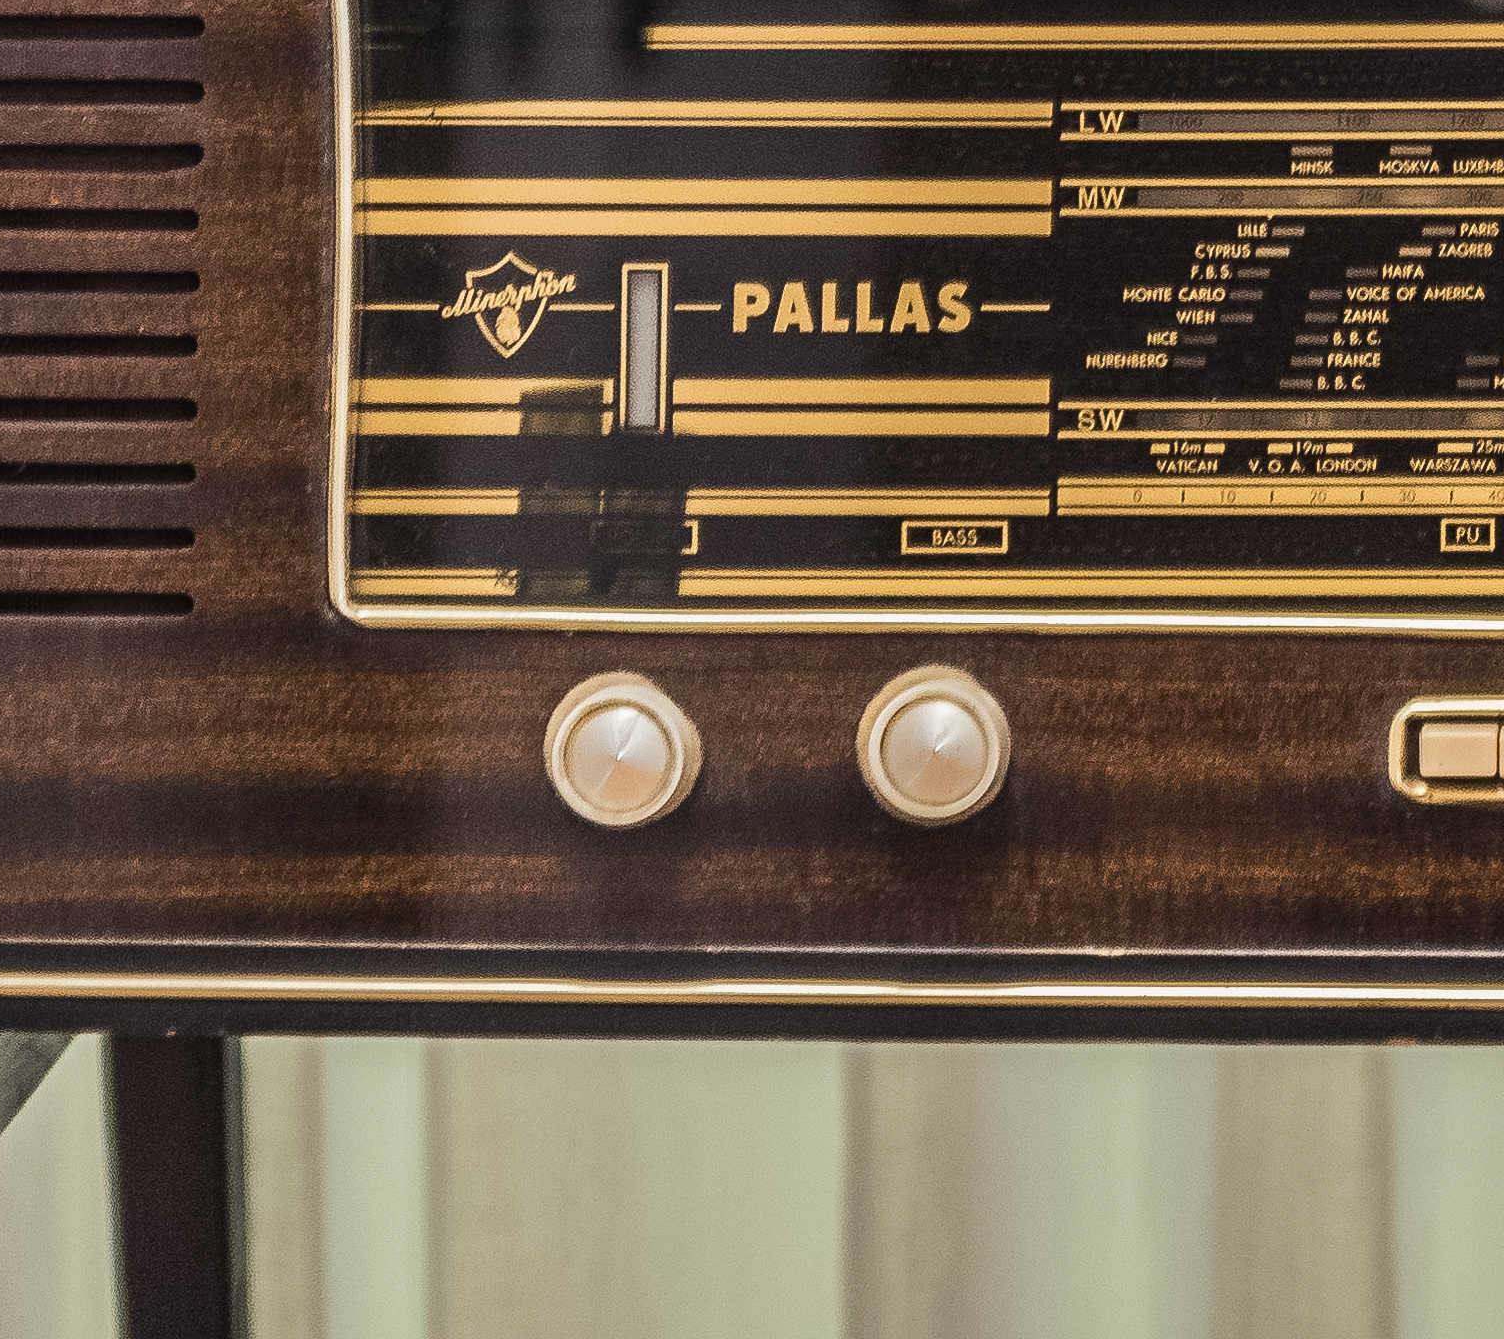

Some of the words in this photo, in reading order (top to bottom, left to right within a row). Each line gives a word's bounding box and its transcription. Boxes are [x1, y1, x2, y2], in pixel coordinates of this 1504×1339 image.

[1078, 111, 1125, 133] LW
[1378, 159, 1440, 174] MOSKVA
[1078, 186, 1125, 209] MW
[1460, 221, 1500, 237] PARIS
[1194, 243, 1252, 260] CYPRUS
[1438, 242, 1493, 258] ZAGREB
[1122, 286, 1173, 303] MONTE
[1177, 286, 1226, 303] CARLO
[1346, 286, 1390, 302] VOICE
[1396, 285, 1417, 302] OF
[1423, 284, 1486, 301] AMERICA
[732, 280, 972, 334] PALLAS
[1175, 309, 1216, 325] WIEN
[1327, 352, 1381, 368] FRANCE
[1076, 409, 1125, 431] SW
[1156, 458, 1218, 474] VATICAN
[1316, 458, 1378, 473] LONDON
[1409, 457, 1497, 473] WARSZAWA
[931, 528, 978, 547] BASS
[1456, 527, 1480, 543] PU
